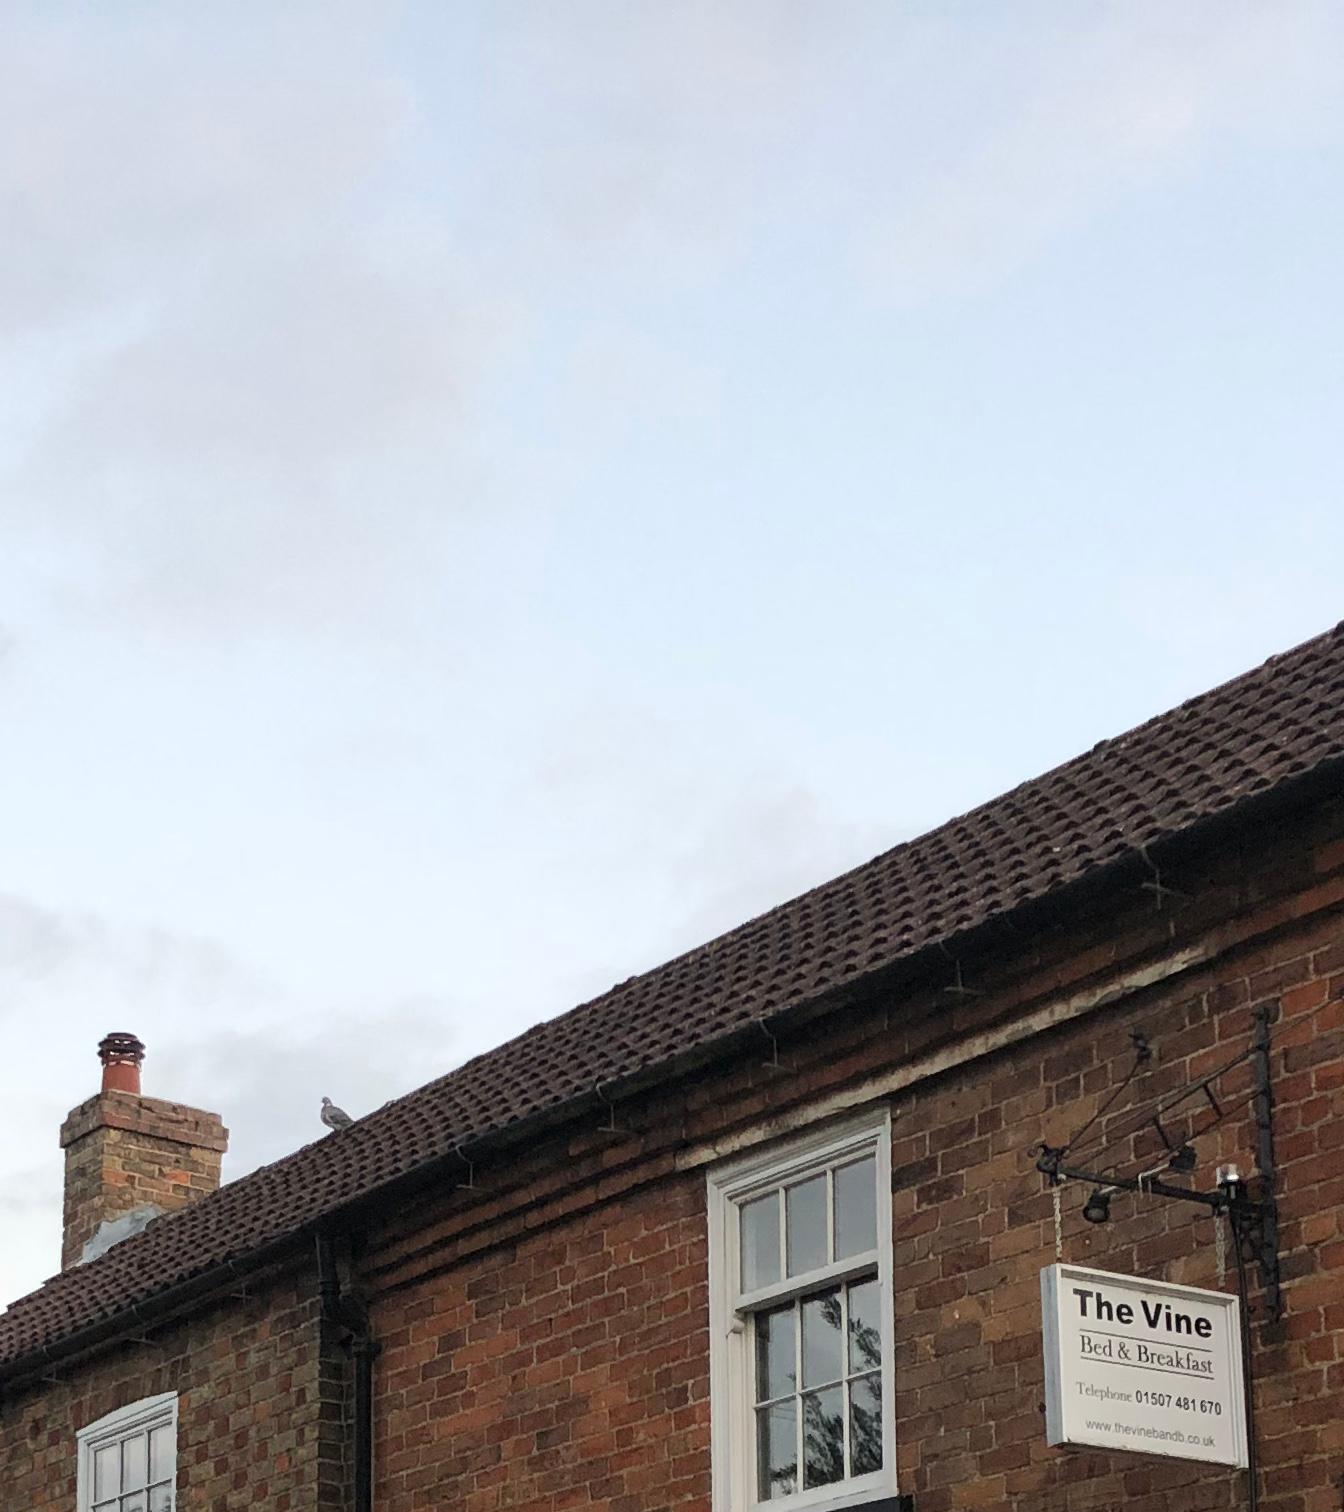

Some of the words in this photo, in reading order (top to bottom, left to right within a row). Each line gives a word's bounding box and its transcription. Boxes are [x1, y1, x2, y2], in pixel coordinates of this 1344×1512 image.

[1074, 1289, 1133, 1324] The
[1141, 1301, 1212, 1338] Vine
[1080, 1335, 1112, 1358] Bed
[1117, 1341, 1132, 1361] &
[1137, 1344, 1213, 1373] Breakfast
[1077, 1382, 1132, 1402] Telephone
[1135, 1390, 1172, 1409] 01507
[1175, 1396, 1197, 1412] 481
[1200, 1398, 1222, 1416] 670
[1086, 1419, 1216, 1447] www.thevinebandb.co.uk
